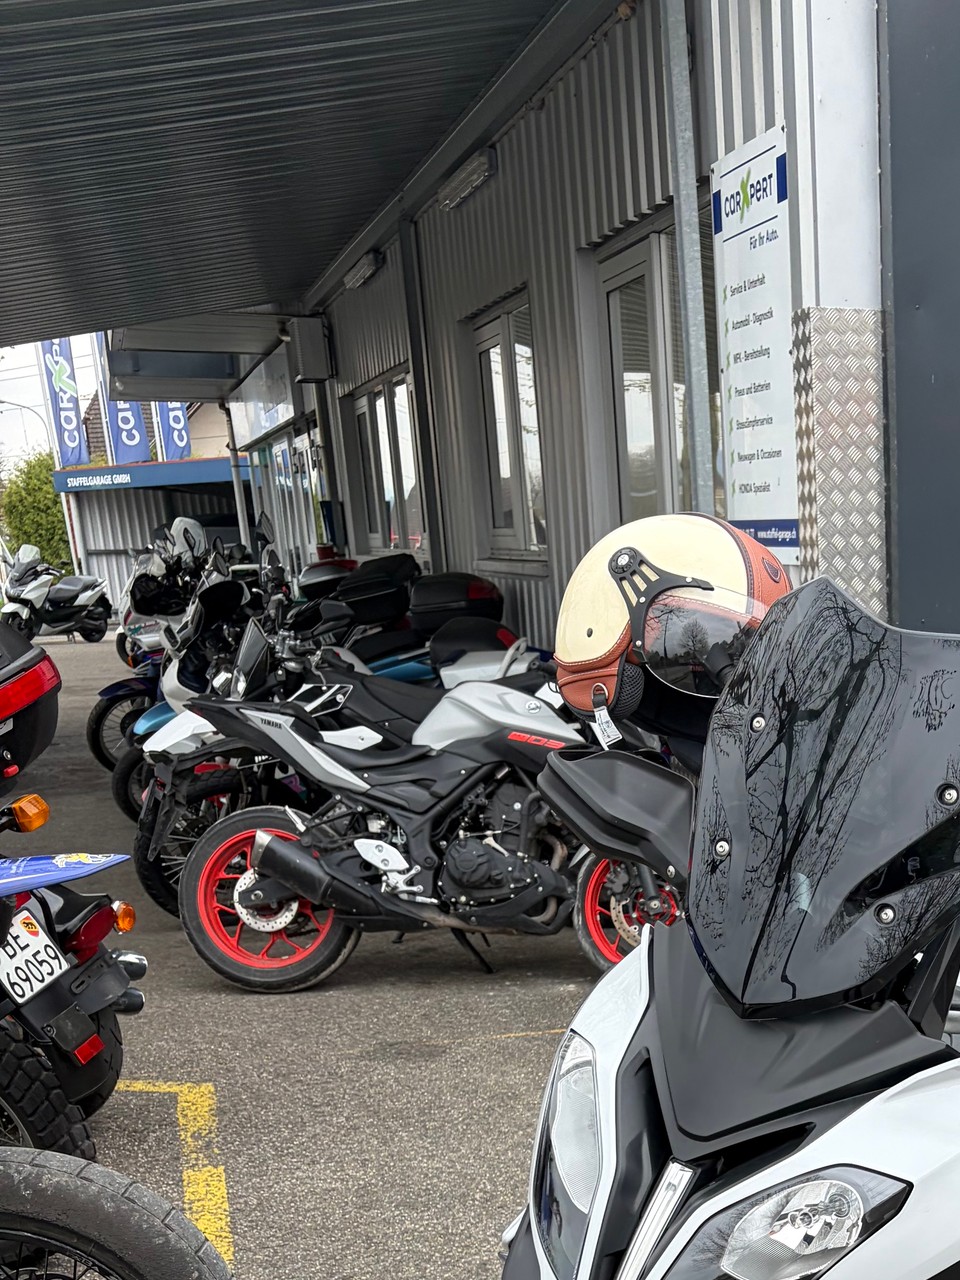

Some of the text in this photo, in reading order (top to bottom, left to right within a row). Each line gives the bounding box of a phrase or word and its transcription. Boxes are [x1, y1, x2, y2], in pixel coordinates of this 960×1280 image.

[749, 235, 757, 251] Für
[730, 282, 743, 297] Service
[747, 272, 766, 290] Unterhalt
[6, 944, 63, 998] 69059
